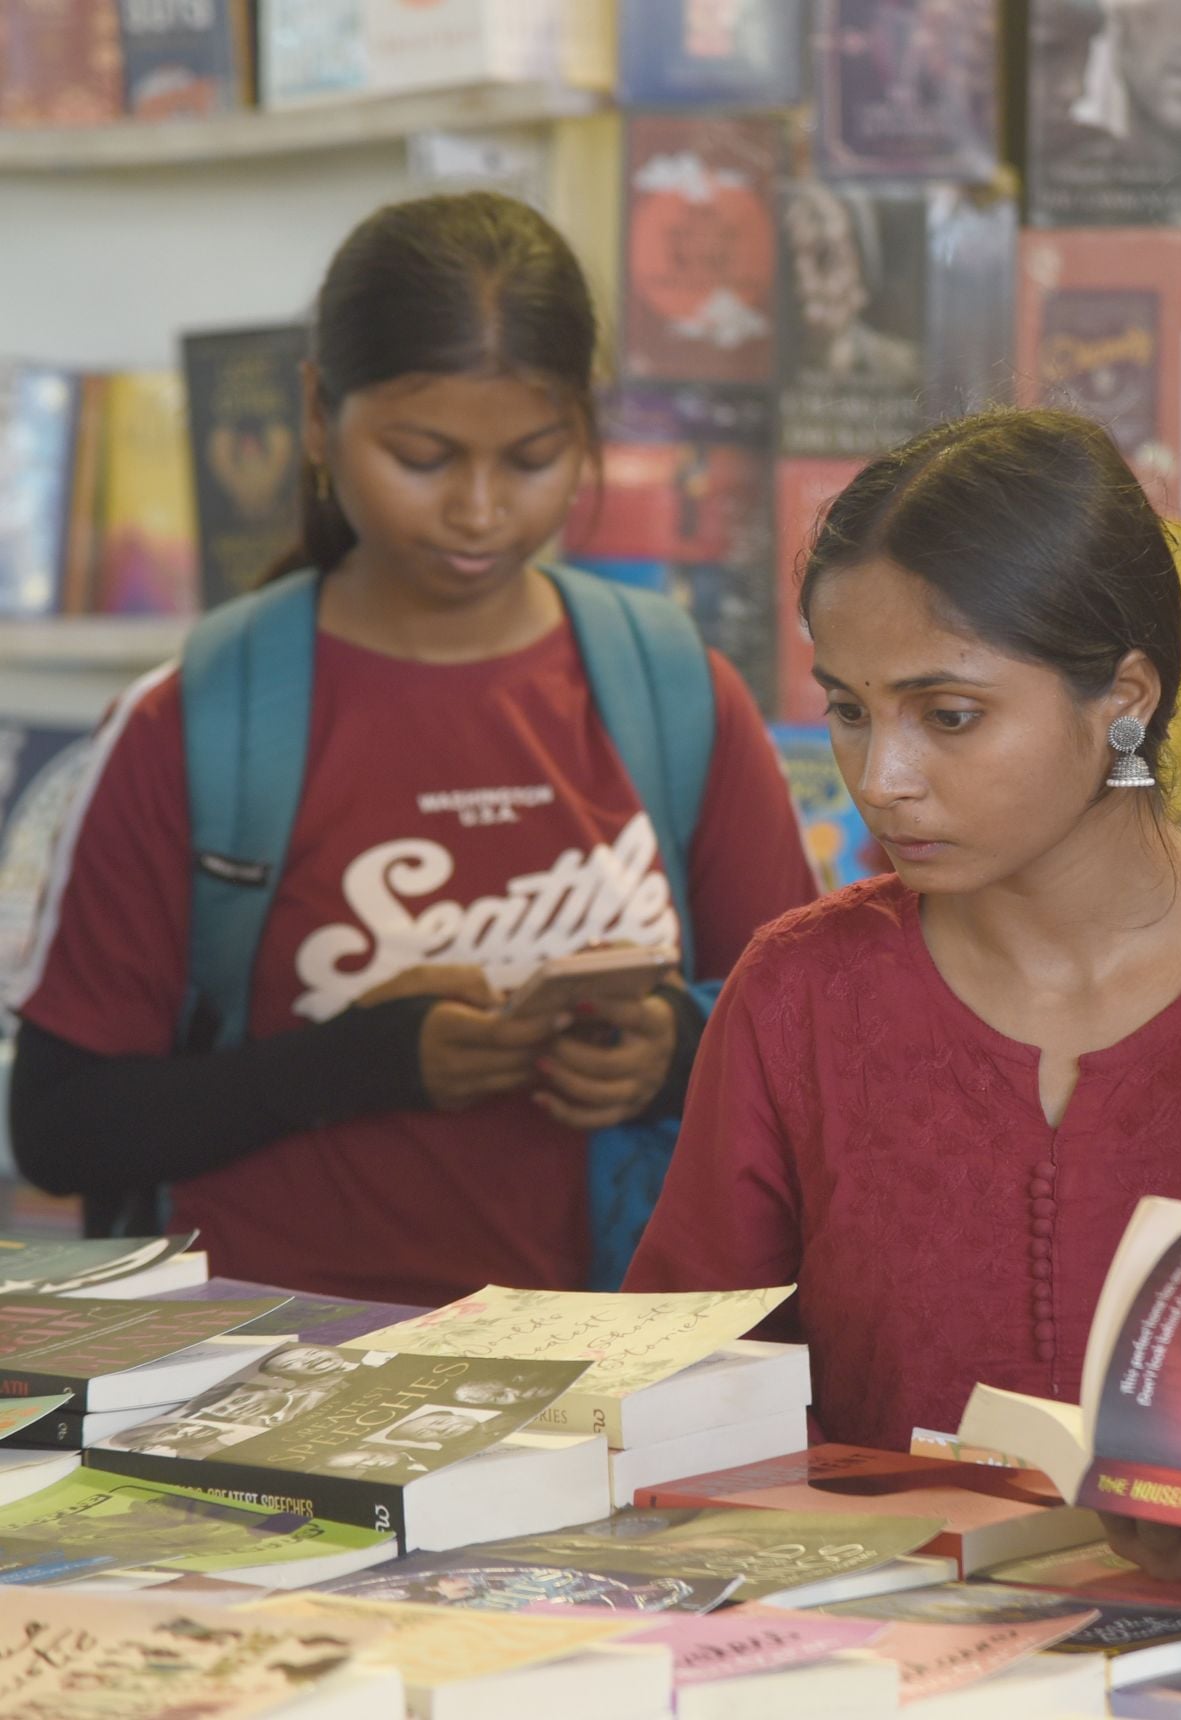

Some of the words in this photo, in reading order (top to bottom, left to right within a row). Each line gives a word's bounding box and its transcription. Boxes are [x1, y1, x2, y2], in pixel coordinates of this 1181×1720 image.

[291, 812, 680, 1023] Seattle
[266, 1361, 470, 1464] SPEECHES
[281, 1385, 393, 1443] GREATEST
